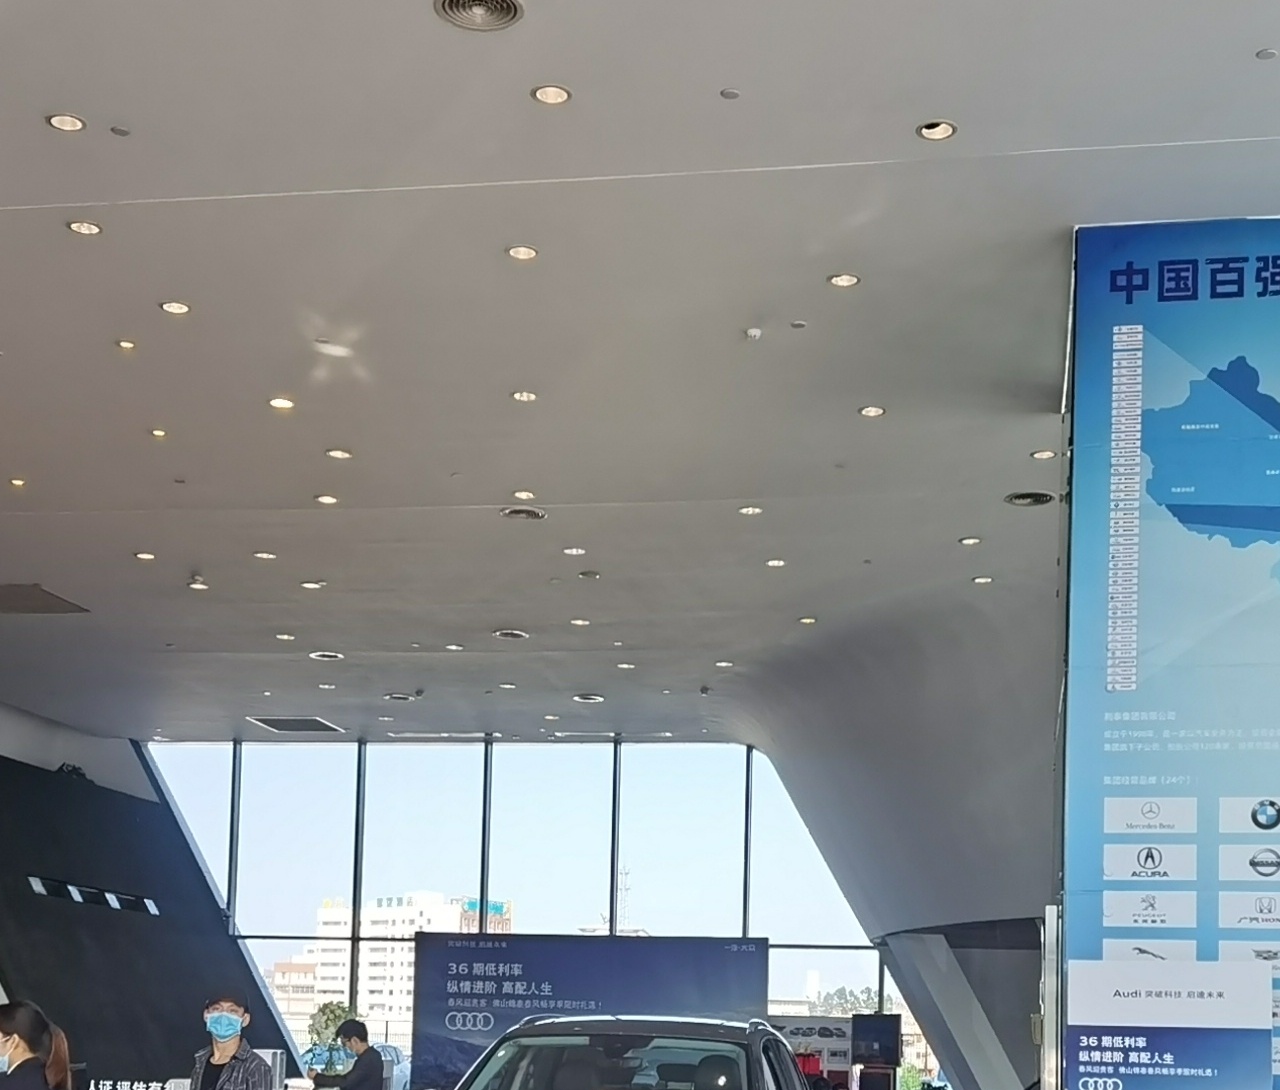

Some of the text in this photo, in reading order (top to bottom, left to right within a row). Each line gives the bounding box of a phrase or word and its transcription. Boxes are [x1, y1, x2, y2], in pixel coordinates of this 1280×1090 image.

[448, 963, 523, 976] 36 期低利率
[447, 980, 553, 995] 纵情进阶 高配人生
[1113, 989, 1141, 998] Audi
[1145, 990, 1182, 999] 突破科技
[1079, 1036, 1147, 1048] 36 期低利率
[1079, 1051, 1174, 1064] 纵情进阶 高配人生
